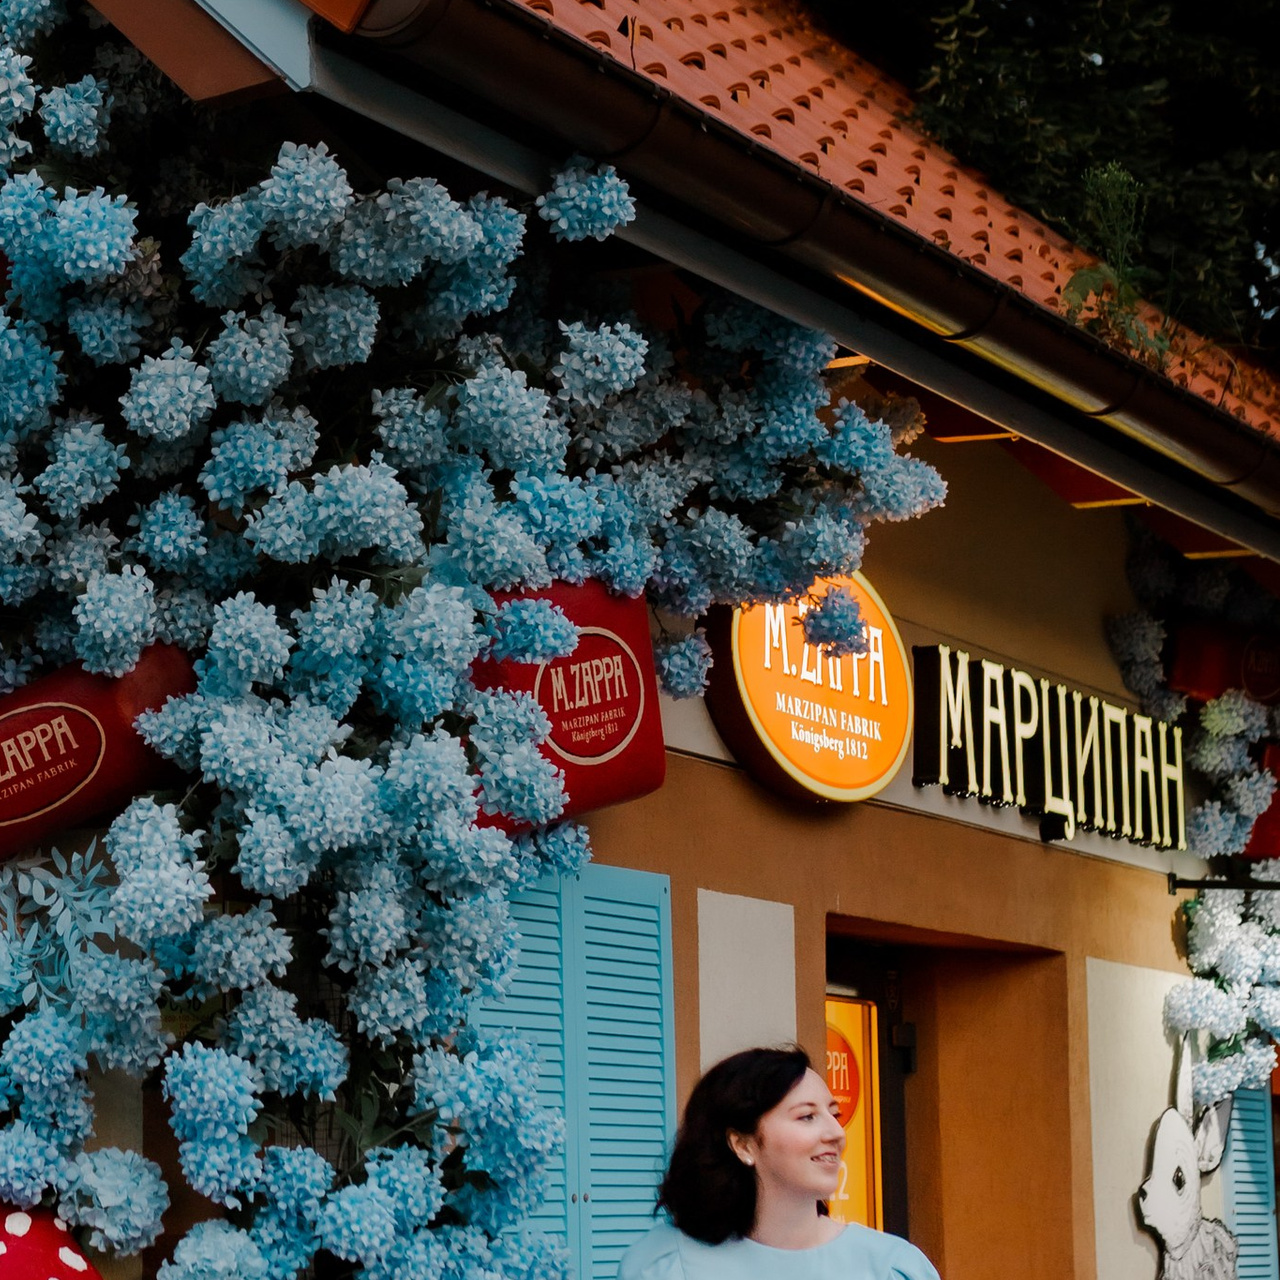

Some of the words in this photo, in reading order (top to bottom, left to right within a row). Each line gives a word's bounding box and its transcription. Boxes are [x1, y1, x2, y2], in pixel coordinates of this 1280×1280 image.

[550, 655, 628, 713] M.ZAPPA
[562, 713, 600, 732] MARZIPAN
[601, 707, 626, 721] FABRIK
[776, 692, 837, 728] MARZIPAN
[840, 712, 882, 741] FABRIK
[791, 721, 845, 758] Königsberg
[846, 738, 868, 760] 1812
[939, 644, 1187, 851] МАРЦИПАН
[37, 758, 78, 783] FABRIK
